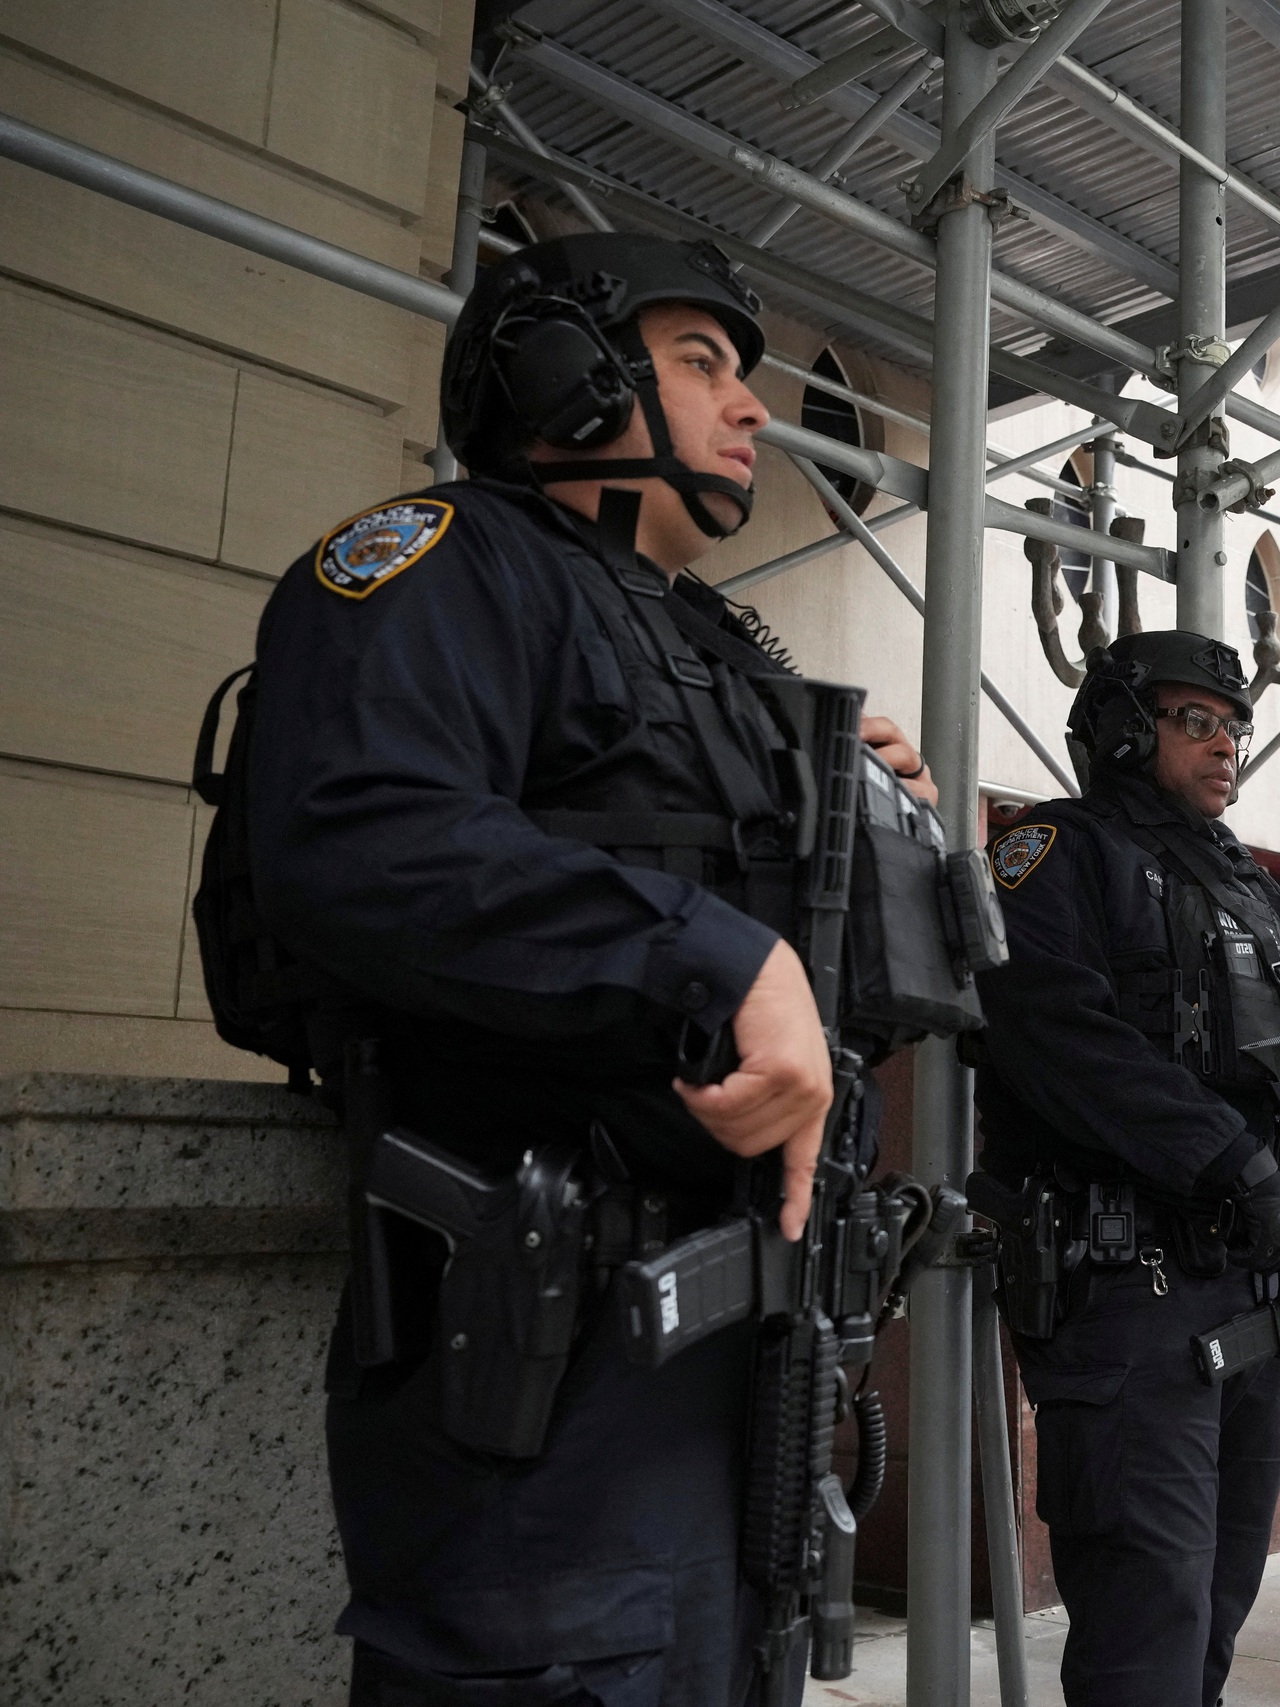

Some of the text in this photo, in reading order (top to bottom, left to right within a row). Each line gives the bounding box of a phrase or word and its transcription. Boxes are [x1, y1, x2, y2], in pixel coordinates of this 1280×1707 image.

[1009, 828, 1039, 840] POLICE
[1017, 843, 1045, 877] NEW YORK
